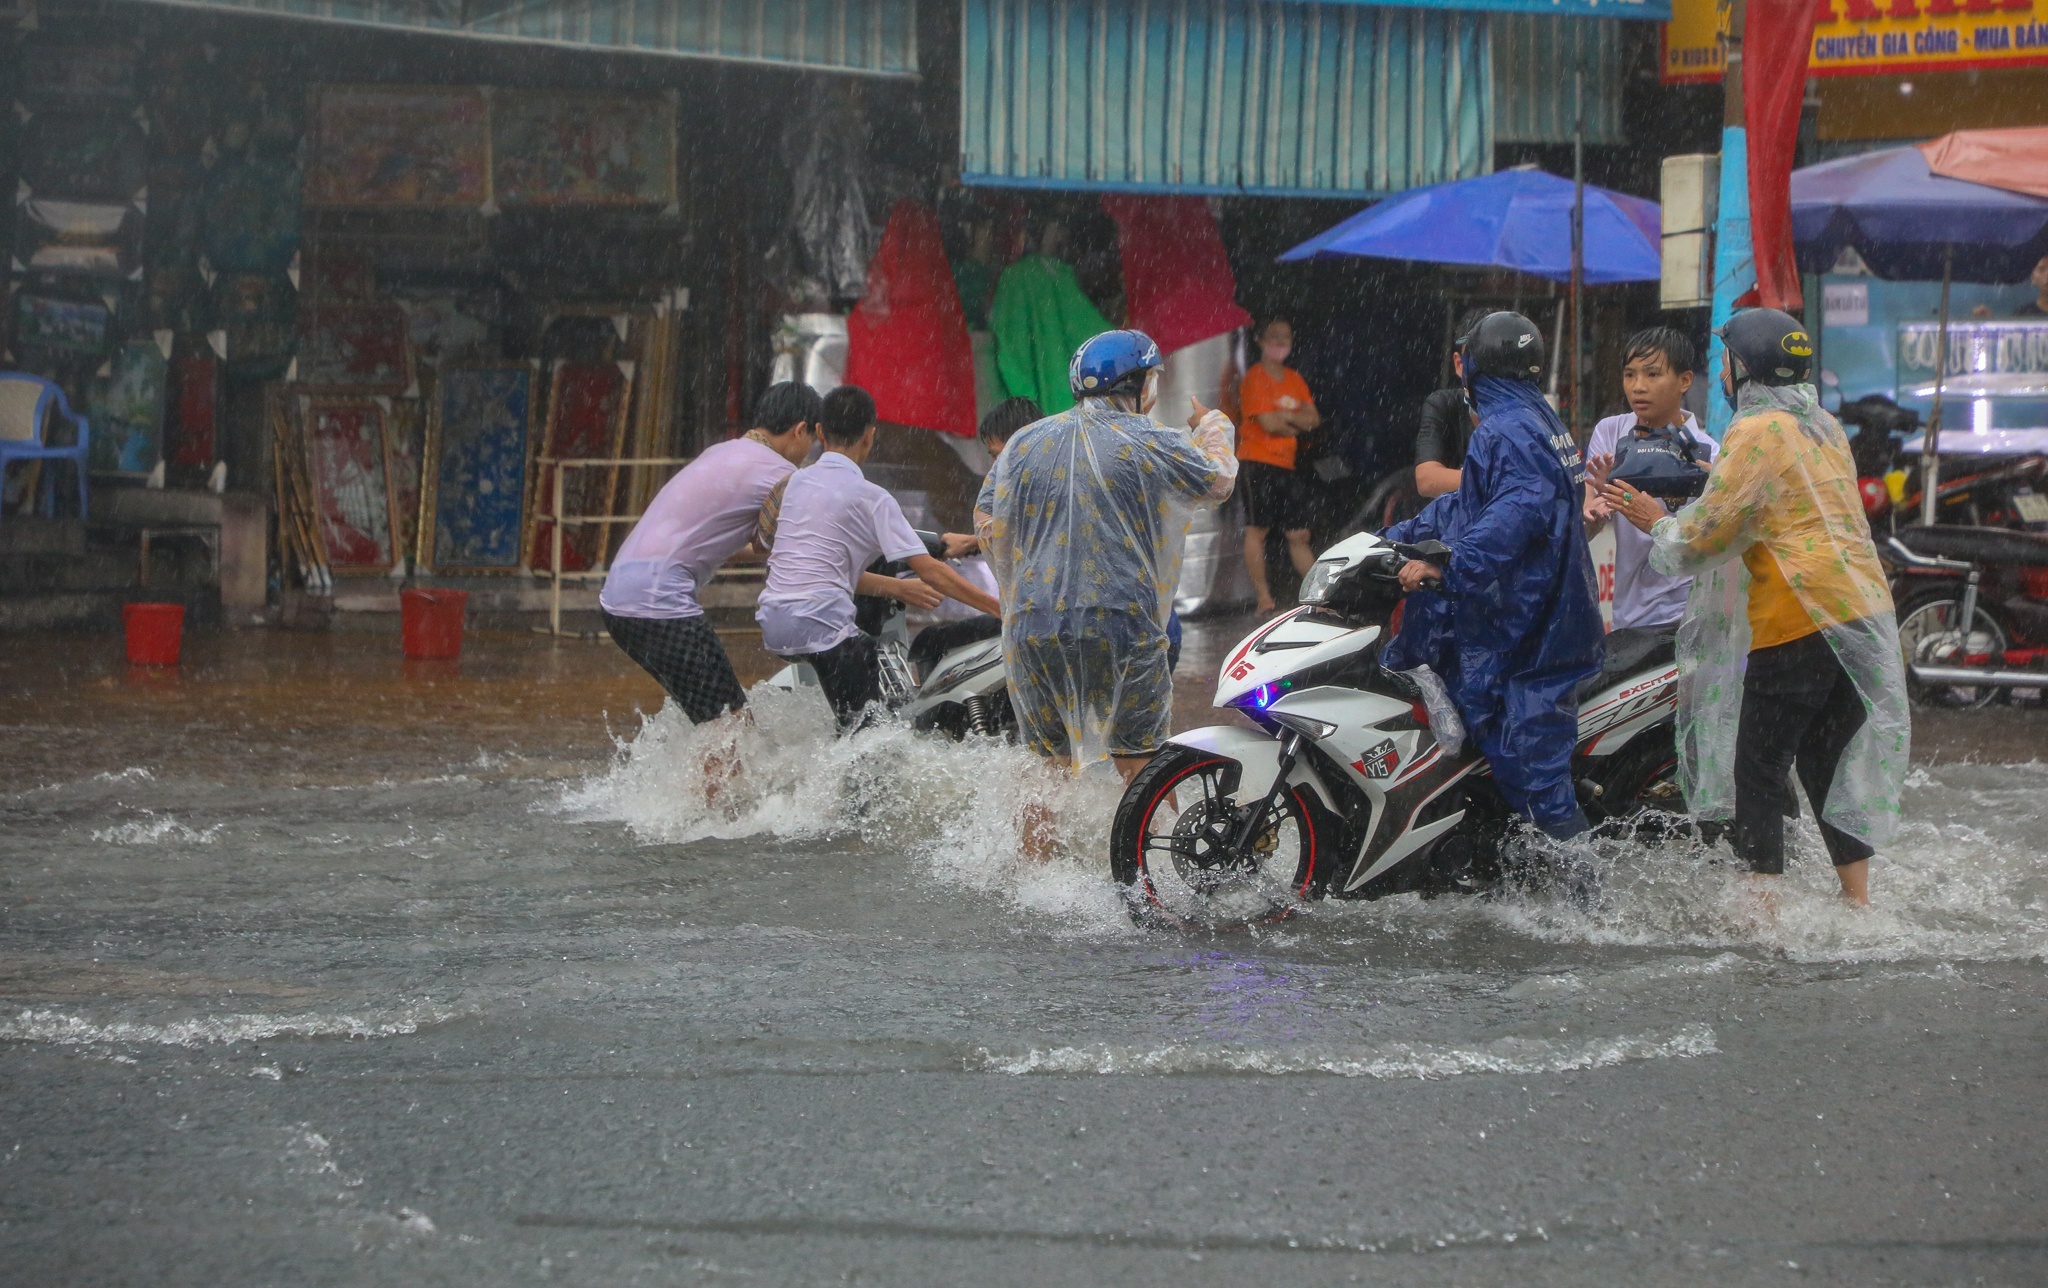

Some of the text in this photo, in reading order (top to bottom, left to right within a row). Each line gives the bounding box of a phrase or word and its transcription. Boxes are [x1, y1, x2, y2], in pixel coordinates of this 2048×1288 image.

[1882, 33, 1908, 56] GIA
[1914, 24, 1957, 54] CÔNG
[1974, 27, 2010, 49] MUA
